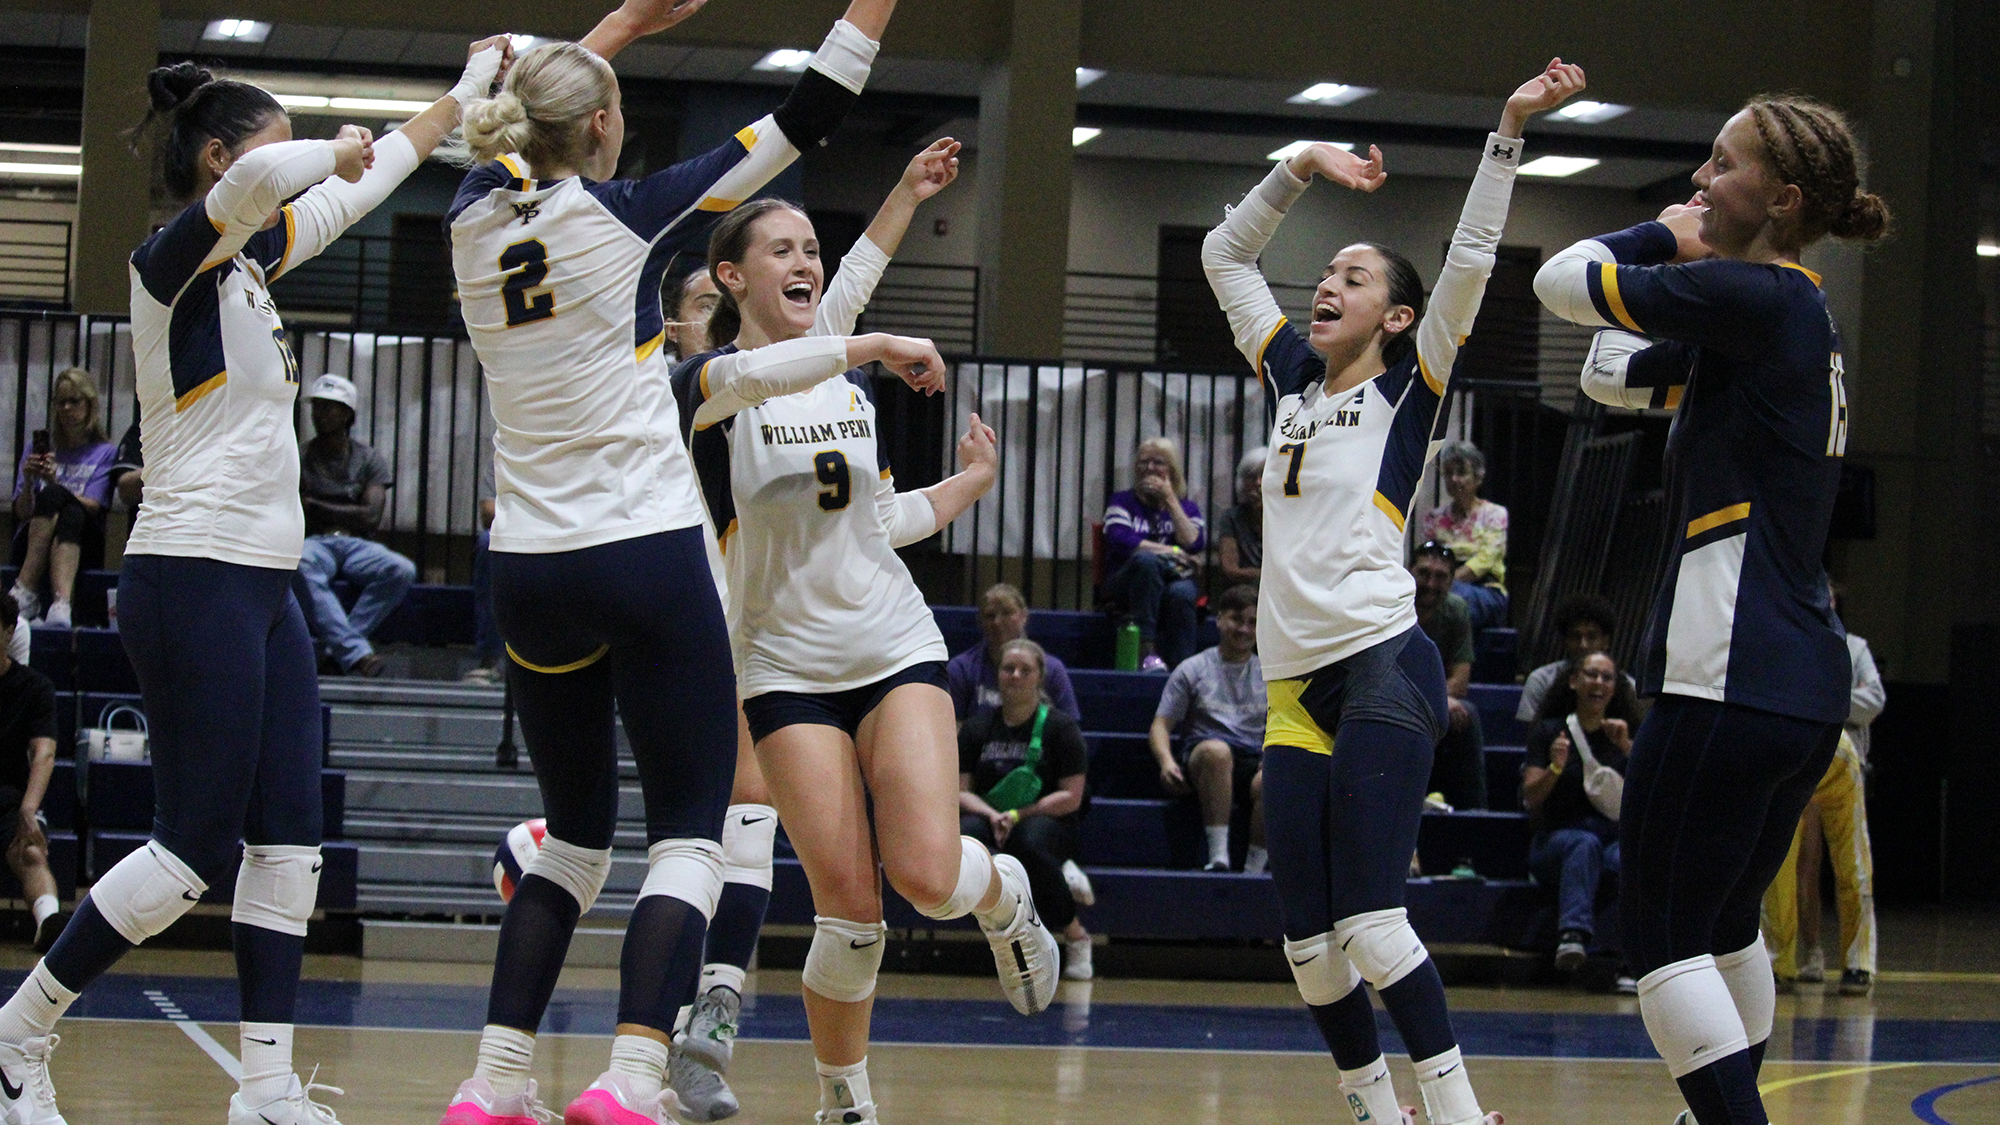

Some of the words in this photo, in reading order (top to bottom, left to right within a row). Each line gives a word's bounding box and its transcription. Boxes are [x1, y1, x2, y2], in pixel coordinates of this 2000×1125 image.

[498, 237, 556, 329] 2
[761, 424, 837, 445] WILLIAM
[837, 419, 872, 439] PENN
[812, 449, 852, 512] 9
[1279, 442, 1307, 497] 7
